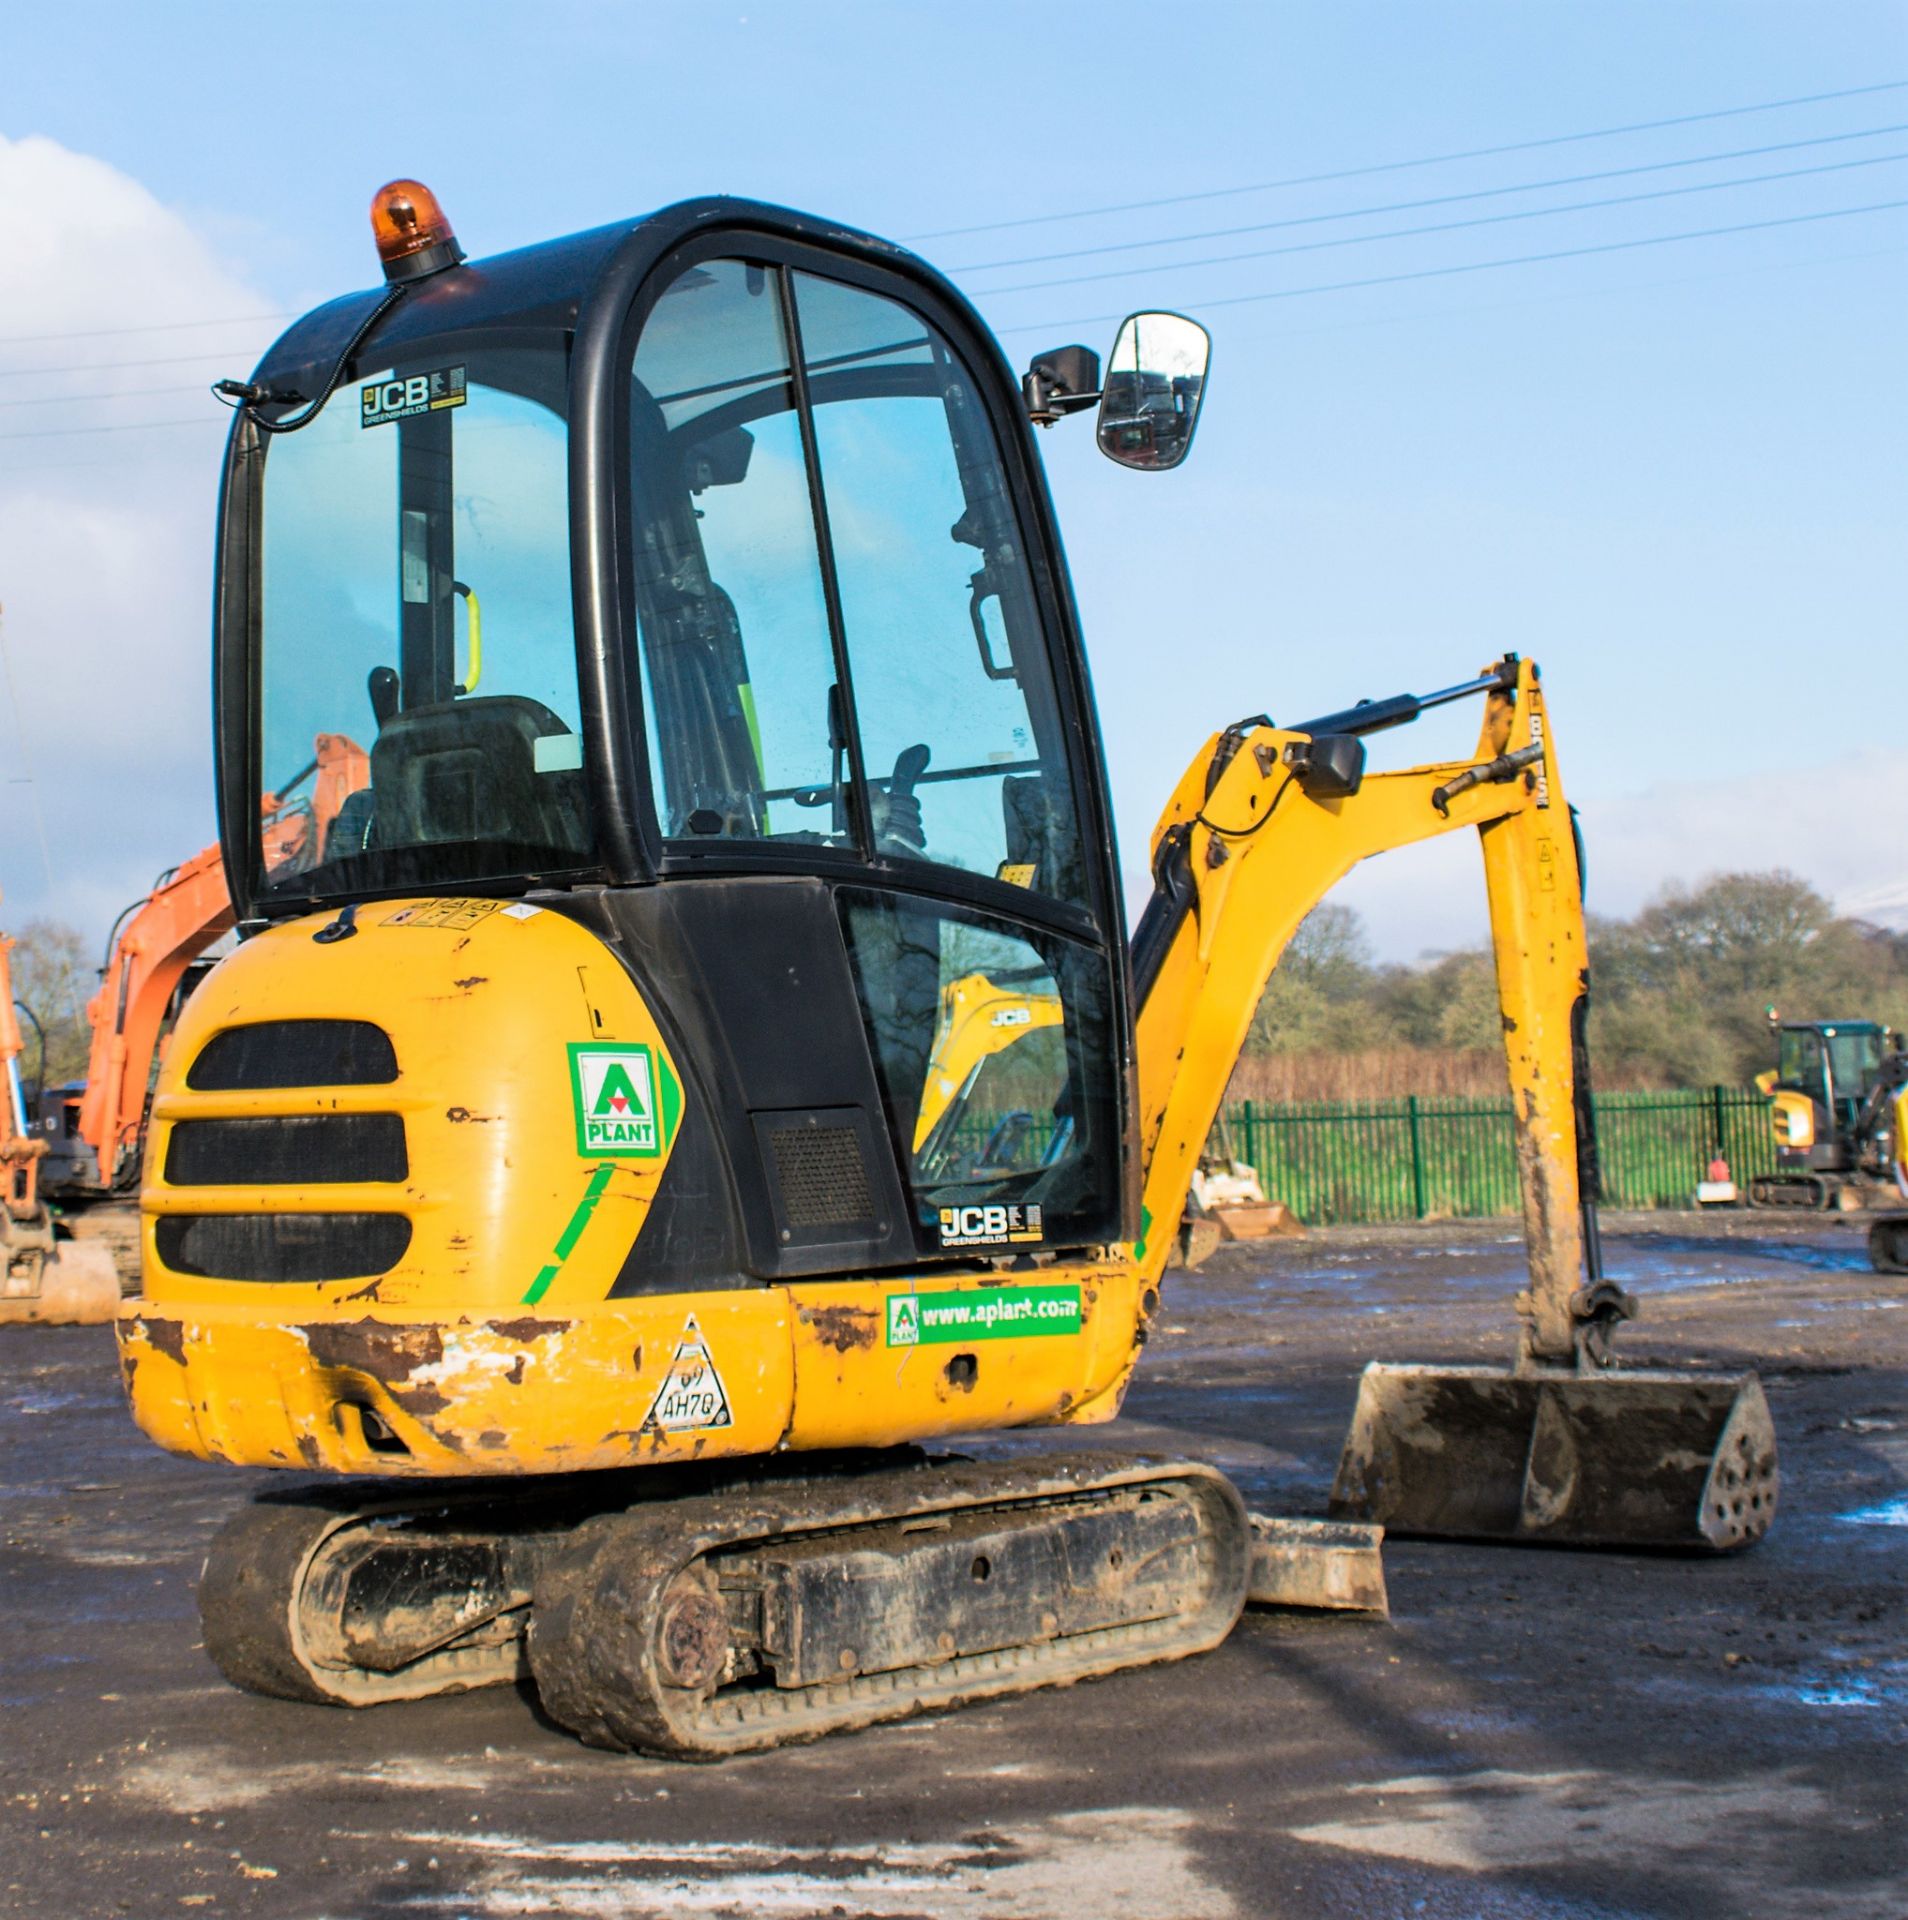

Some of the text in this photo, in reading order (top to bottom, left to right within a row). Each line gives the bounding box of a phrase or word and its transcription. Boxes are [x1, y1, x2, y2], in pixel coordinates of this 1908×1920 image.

[362, 376, 428, 416] JCB
[363, 403, 429, 425] GREENSHIELDS
[991, 1008, 1031, 1027] JCB
[592, 1063, 646, 1115] A
[587, 1123, 652, 1142] PLANT
[940, 1206, 1008, 1237] JCB
[942, 1234, 1008, 1247] GREENSHIELDS
[895, 1303, 915, 1329] A
